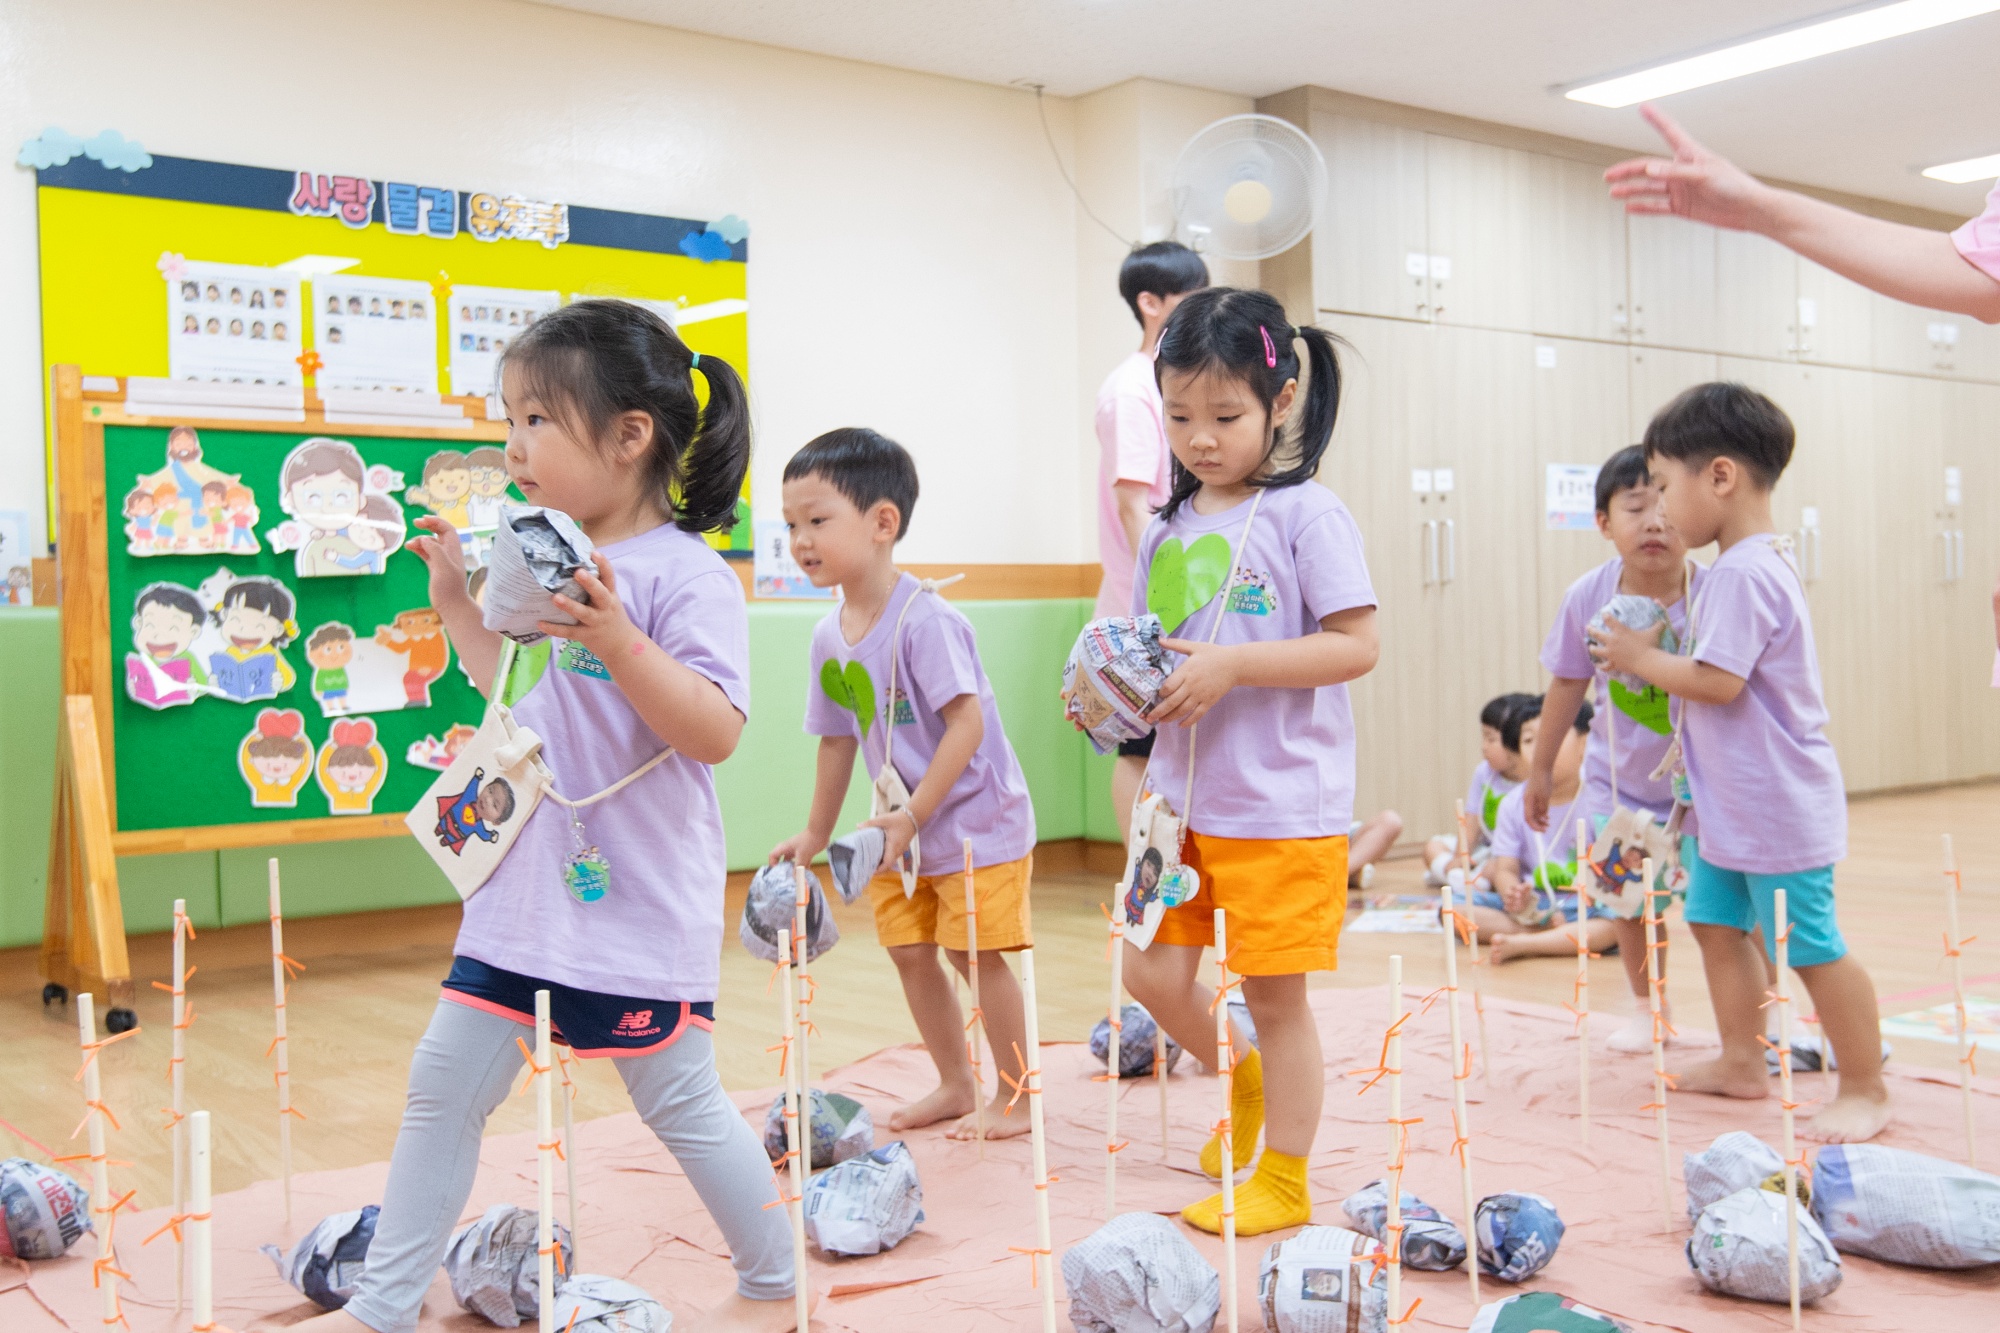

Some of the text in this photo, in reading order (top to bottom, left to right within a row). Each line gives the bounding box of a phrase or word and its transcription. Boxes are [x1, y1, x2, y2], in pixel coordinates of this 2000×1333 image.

[293, 171, 373, 226] 사랑
[387, 181, 455, 231] 물결
[628, 1026, 661, 1037] balance
